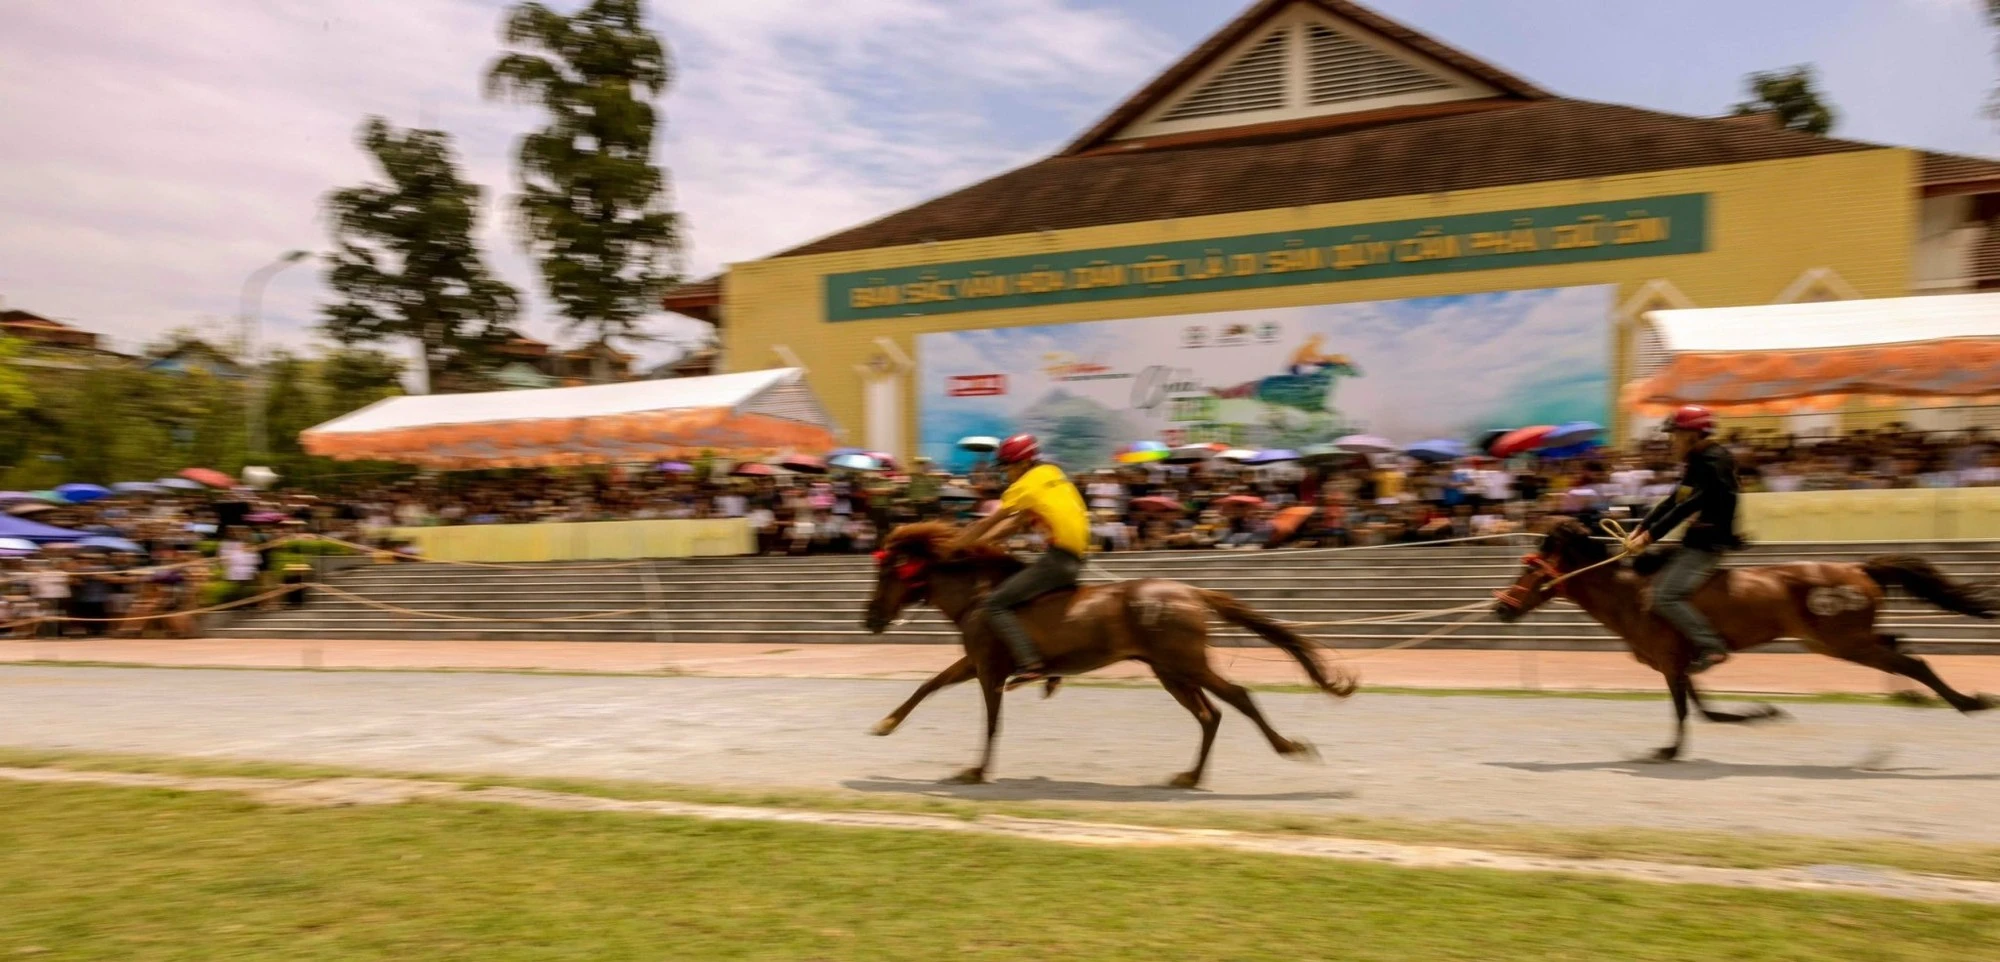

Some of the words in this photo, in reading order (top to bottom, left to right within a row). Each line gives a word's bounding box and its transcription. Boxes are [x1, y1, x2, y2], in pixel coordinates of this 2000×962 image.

[849, 277, 900, 308] BẢN
[902, 270, 956, 304] SẮC
[957, 270, 1007, 300] VĂN
[1010, 264, 1066, 294] HÓA
[1070, 260, 1127, 290] DÂN
[1130, 255, 1184, 289] TỘC
[1185, 249, 1226, 282] LÀ
[1229, 253, 1260, 277] DI
[1264, 239, 1322, 274] SẢN
[1395, 225, 1460, 263] CẦN
[1614, 209, 1672, 246] GÌN
